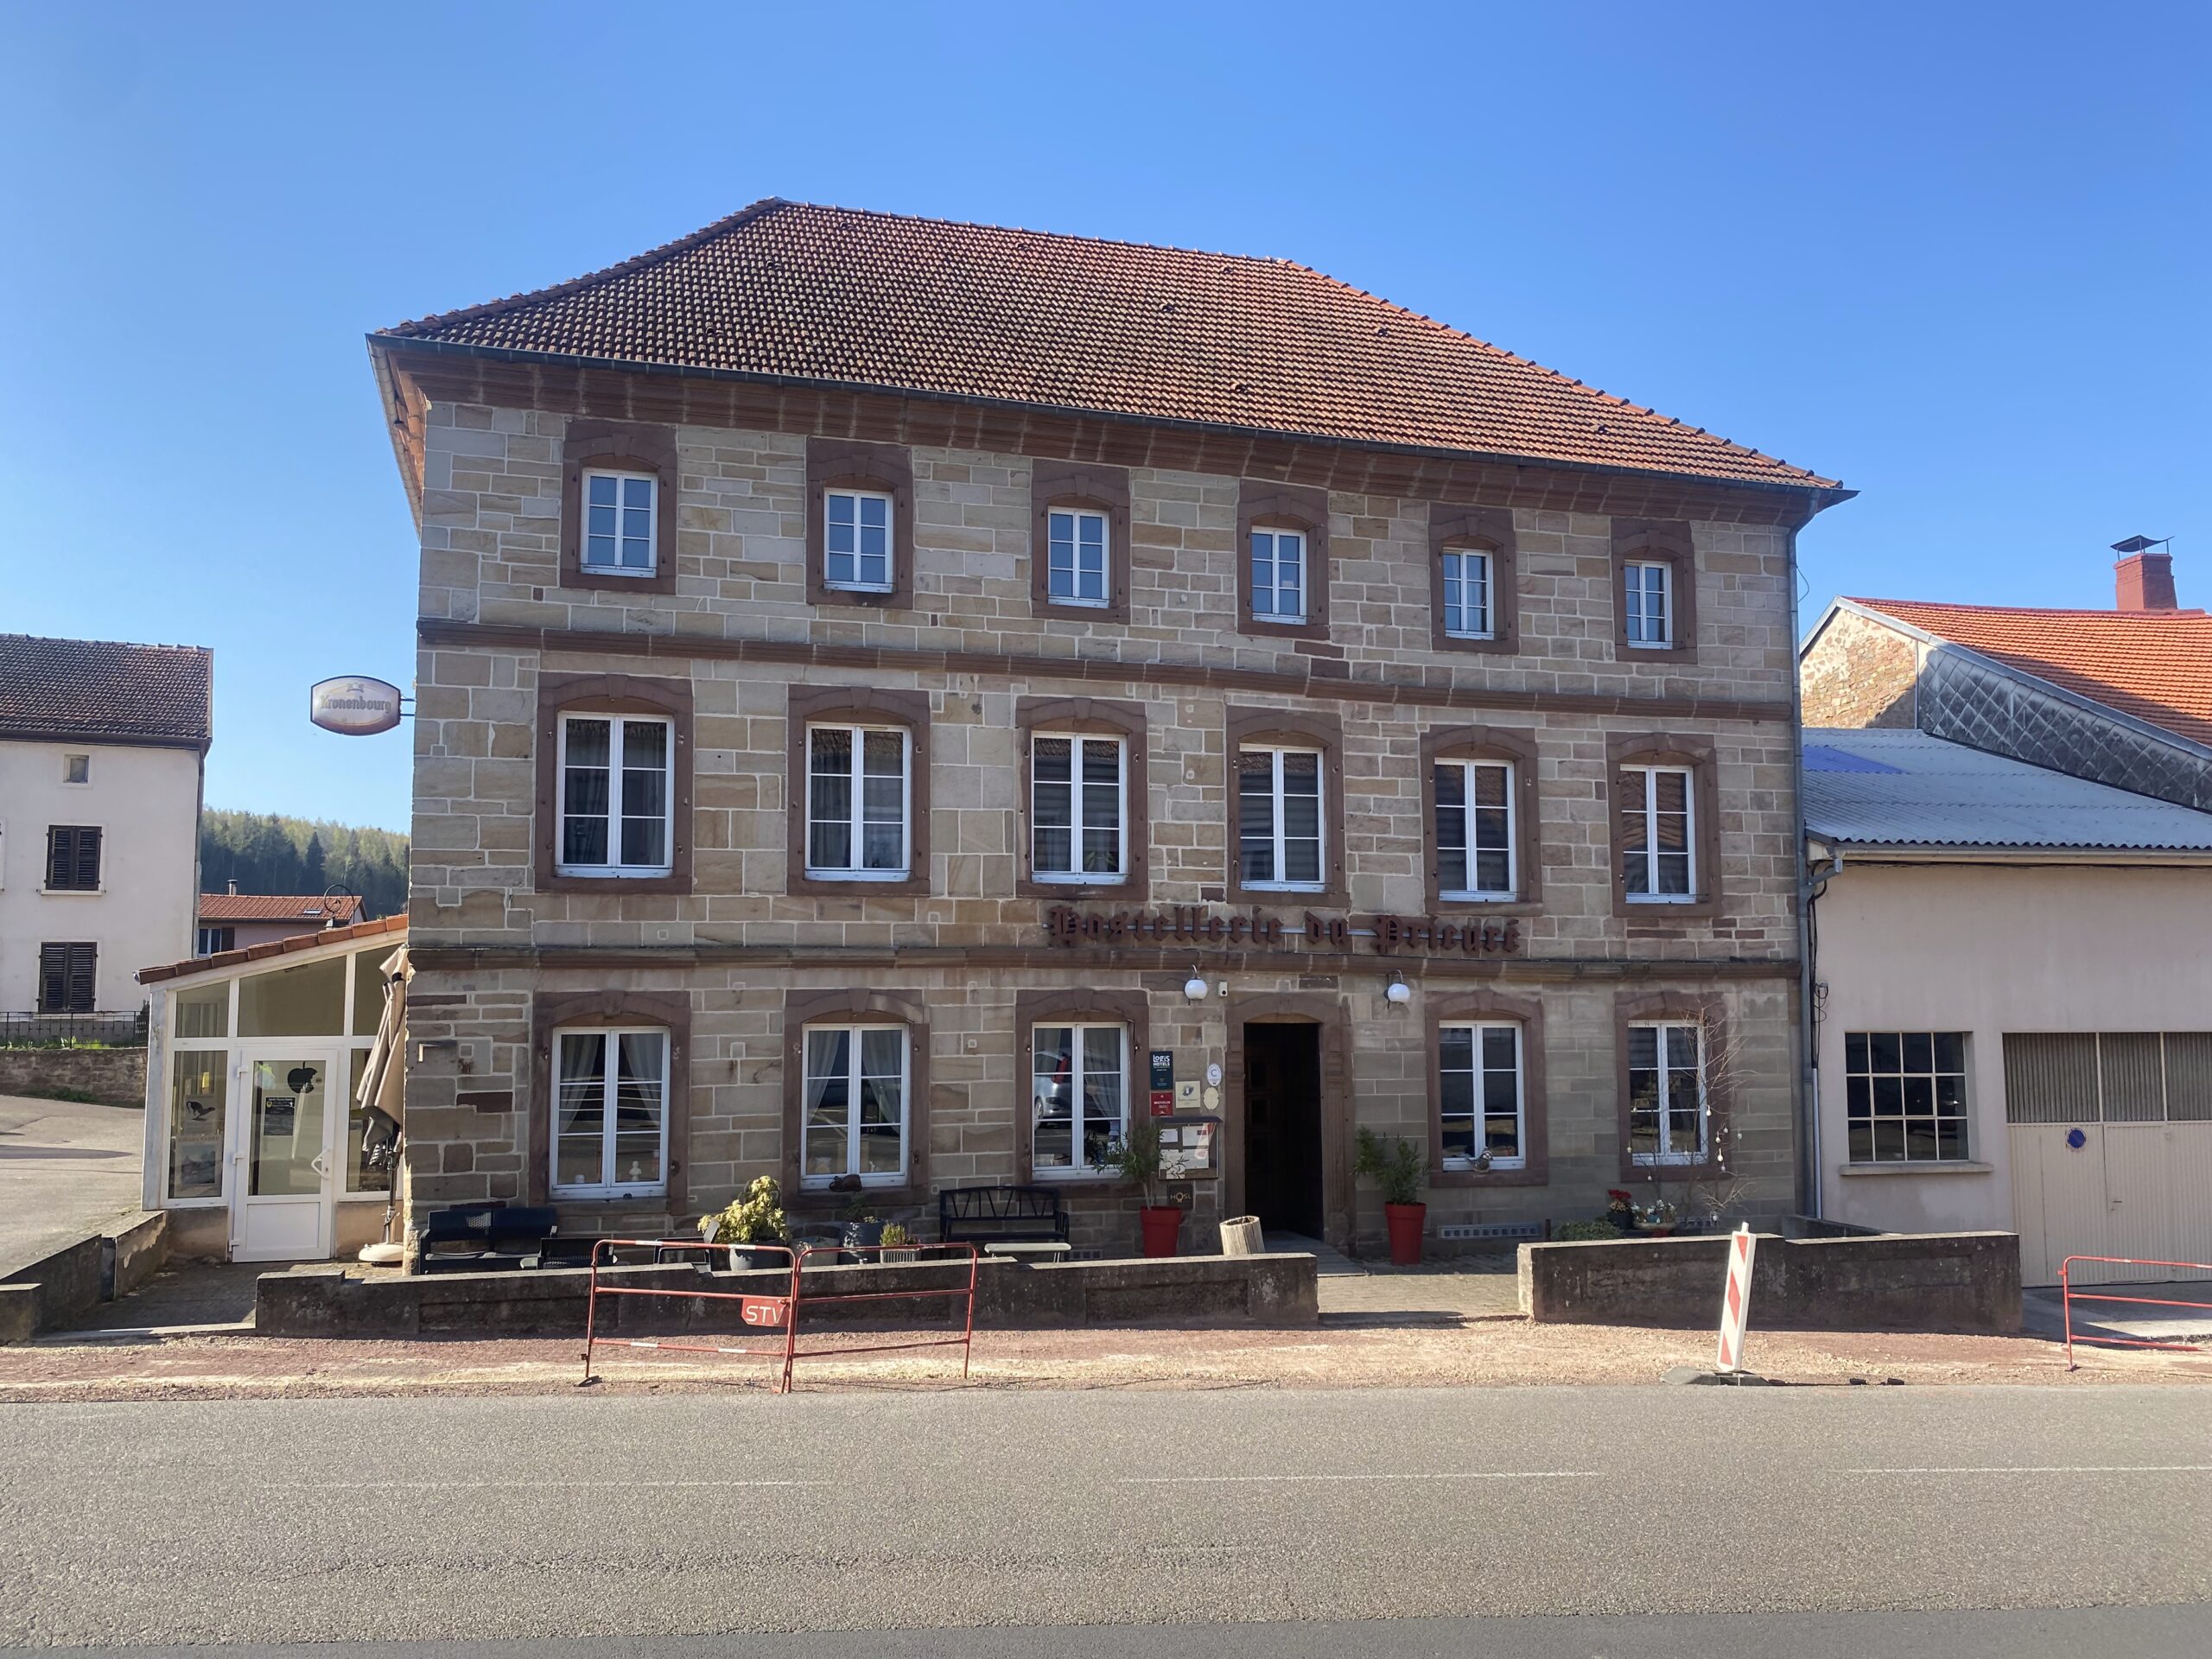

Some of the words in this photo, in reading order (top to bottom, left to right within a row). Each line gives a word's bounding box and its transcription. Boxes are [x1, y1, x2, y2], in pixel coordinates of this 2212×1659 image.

[320, 695, 392, 715] Kronenbourg
[1049, 905, 1284, 945] Hostellerie
[1304, 910, 1350, 945] du
[1371, 914, 1521, 954] Prieuré
[746, 1305, 785, 1324] STV
